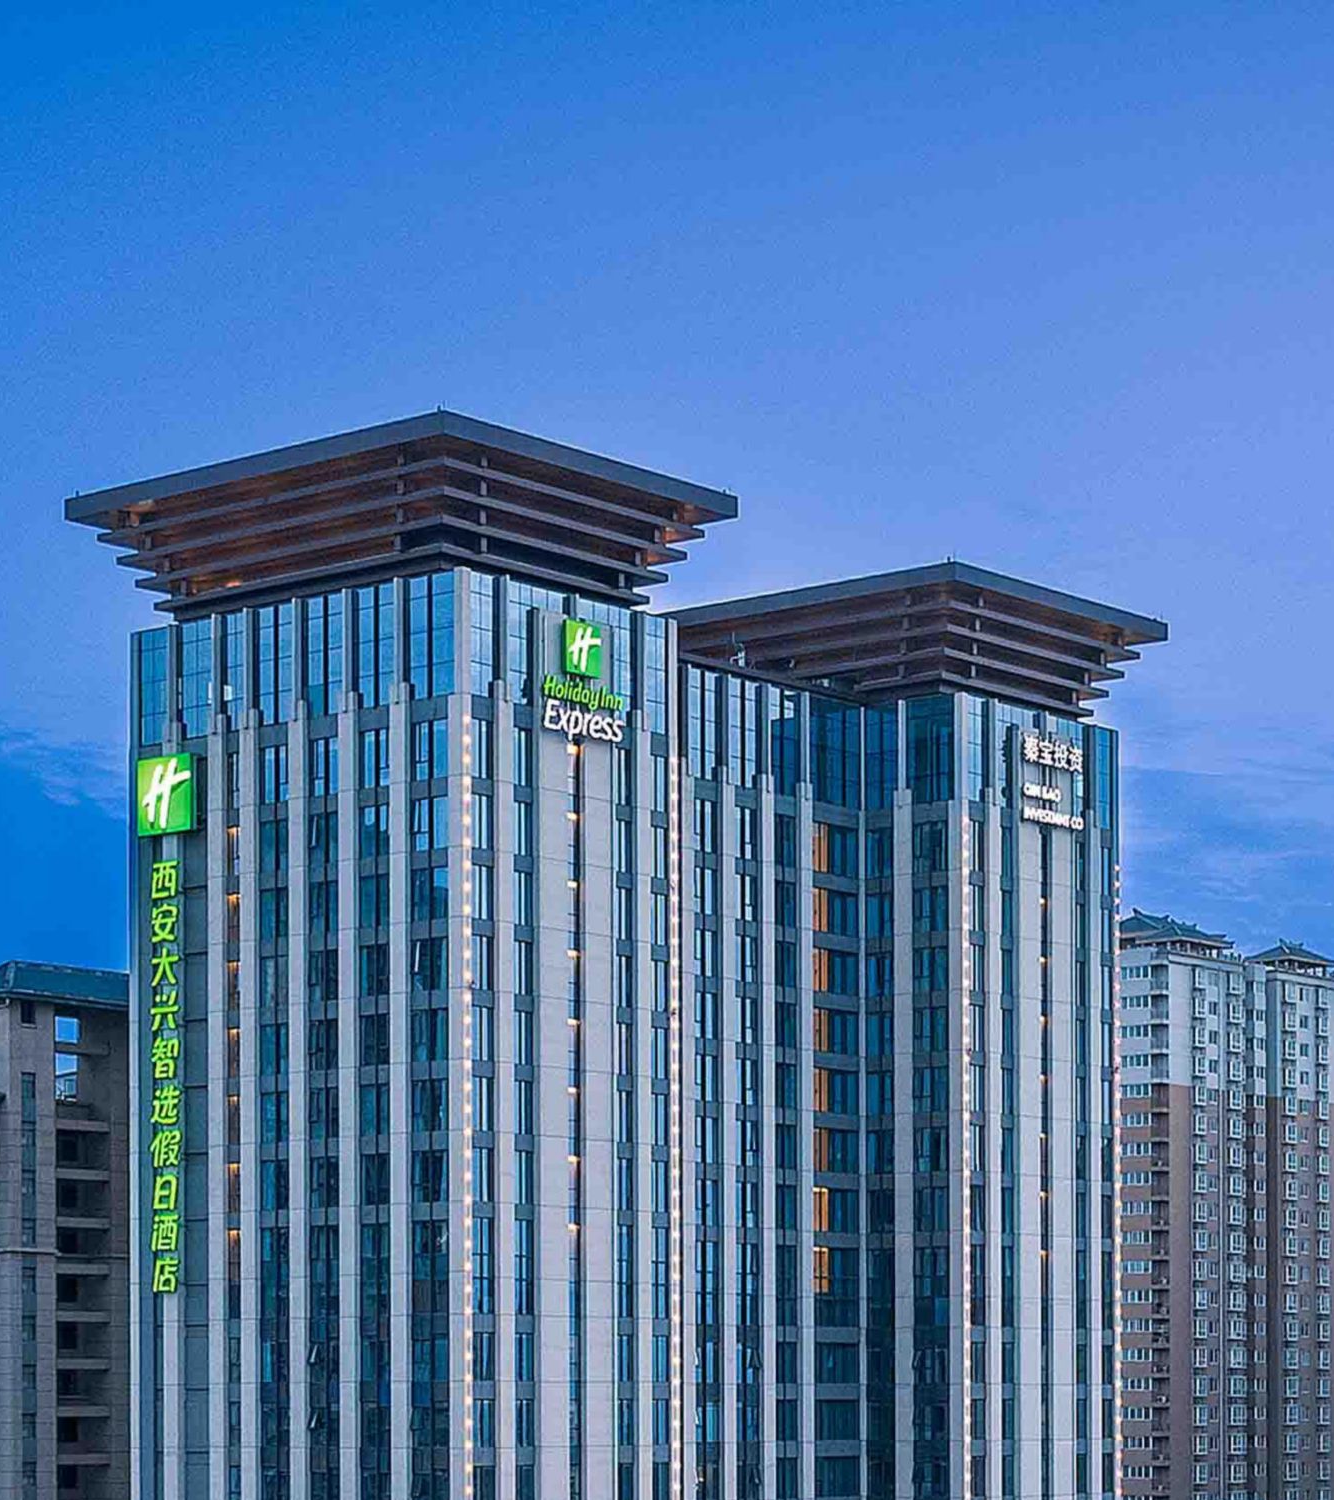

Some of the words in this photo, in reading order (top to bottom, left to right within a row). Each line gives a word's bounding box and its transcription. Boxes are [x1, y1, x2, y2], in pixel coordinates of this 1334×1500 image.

[544, 674, 600, 711] Holiday
[601, 685, 624, 711] Inn
[543, 698, 626, 742] Express
[150, 860, 180, 1293] 西安大兴智选假日酒店
